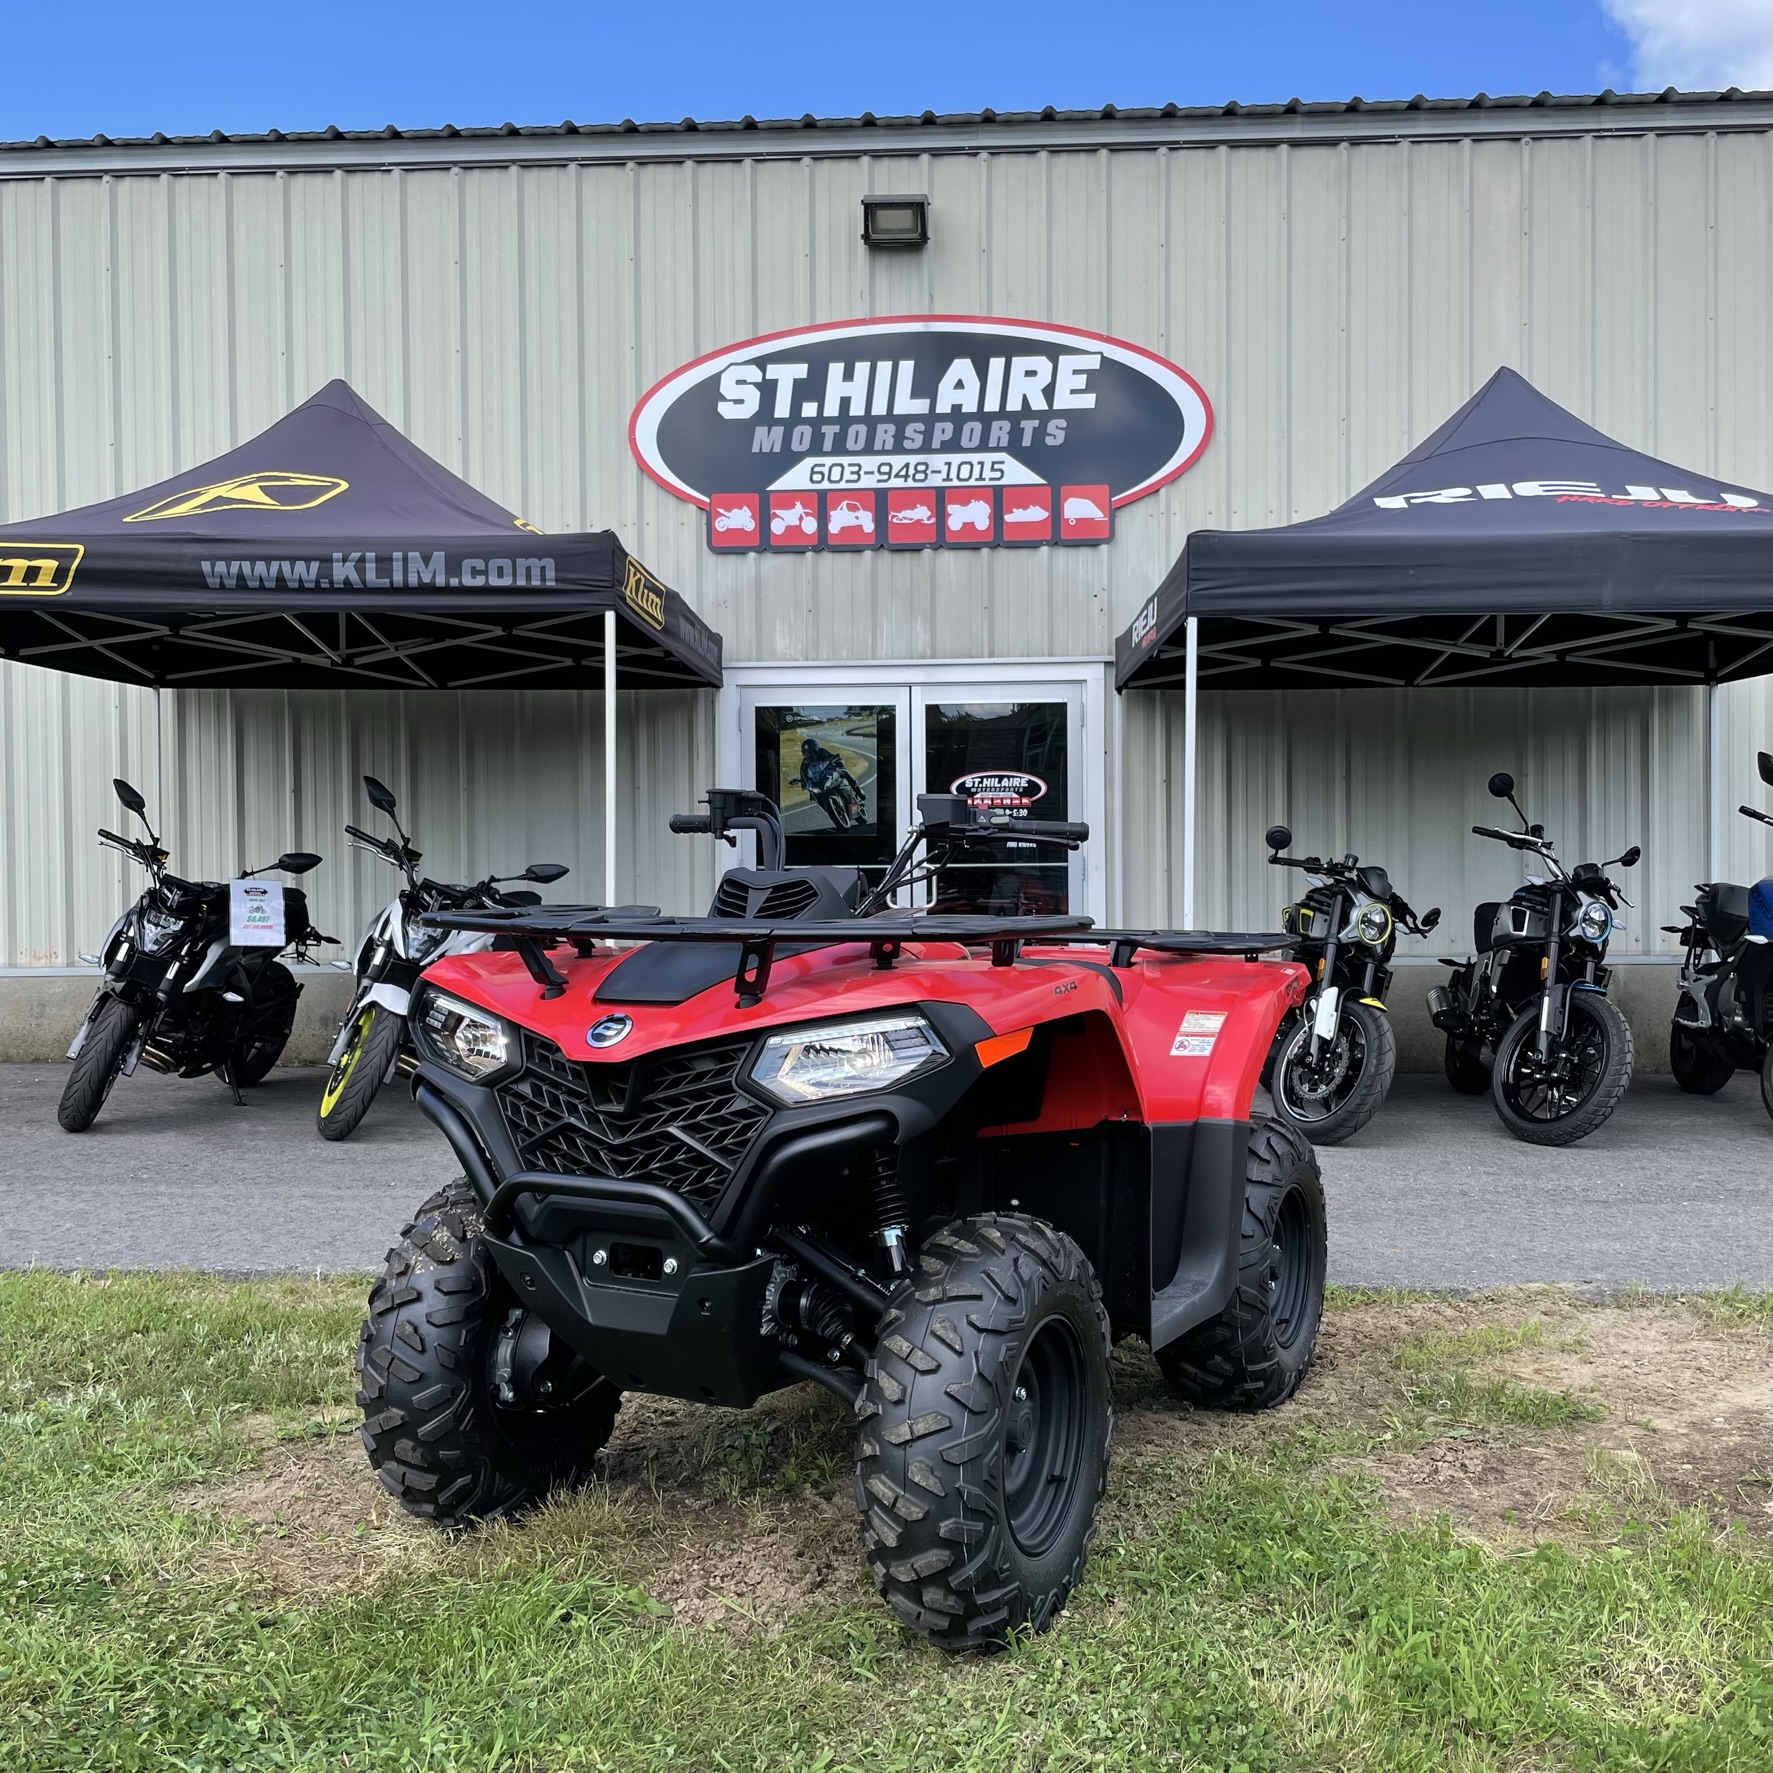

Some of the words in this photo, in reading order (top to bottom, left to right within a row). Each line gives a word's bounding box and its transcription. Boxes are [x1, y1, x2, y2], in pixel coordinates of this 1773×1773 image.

[717, 353, 1102, 420] ST.HILAIRE
[751, 418, 1068, 454] MOTORSPORTS
[808, 457, 1006, 484] 603-948-1015
[1373, 480, 1759, 509] RIEJU
[200, 551, 556, 589] www.KLIM.com
[626, 564, 663, 623] Klim
[1132, 596, 1157, 648] RIEJU
[965, 777, 1029, 788] ST.HILAIRE
